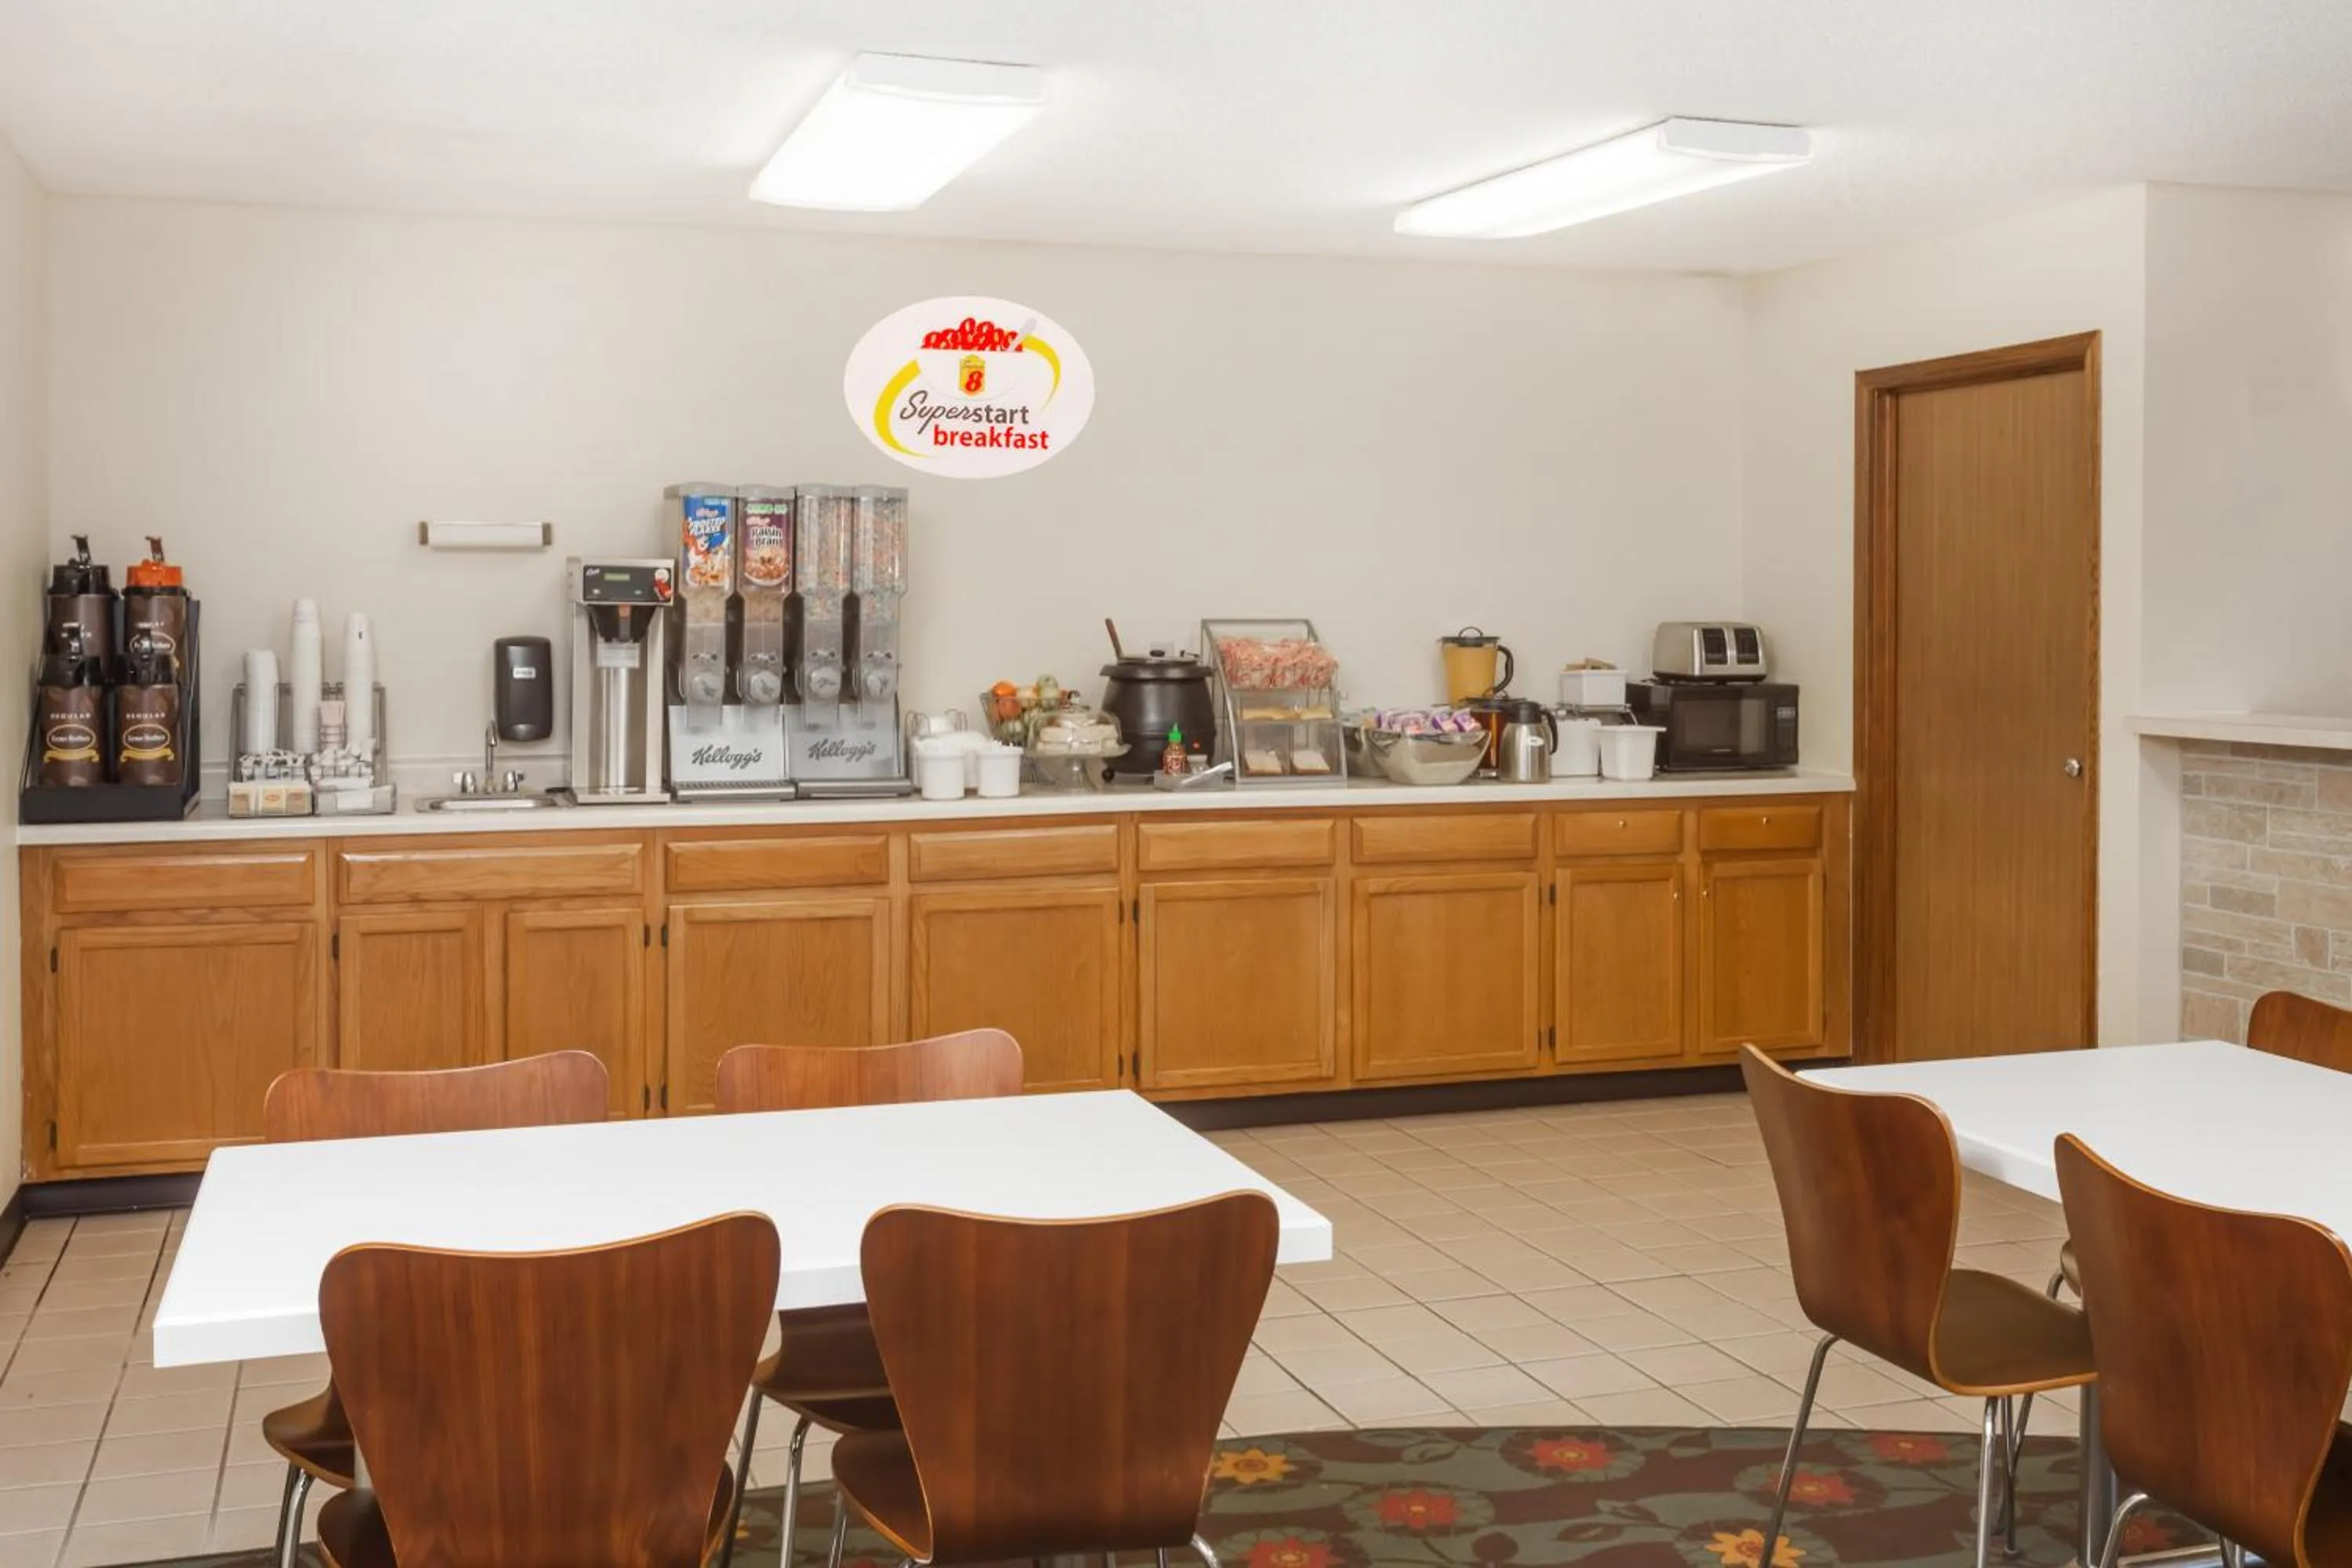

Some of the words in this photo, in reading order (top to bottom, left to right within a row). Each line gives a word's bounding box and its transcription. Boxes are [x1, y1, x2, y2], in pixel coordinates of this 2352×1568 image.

[965, 371, 983, 392] 8
[900, 390, 1029, 434] Superstart
[933, 424, 1049, 449] breakfast
[691, 744, 762, 770] Kellogg's
[808, 738, 877, 764] Kellogg's
